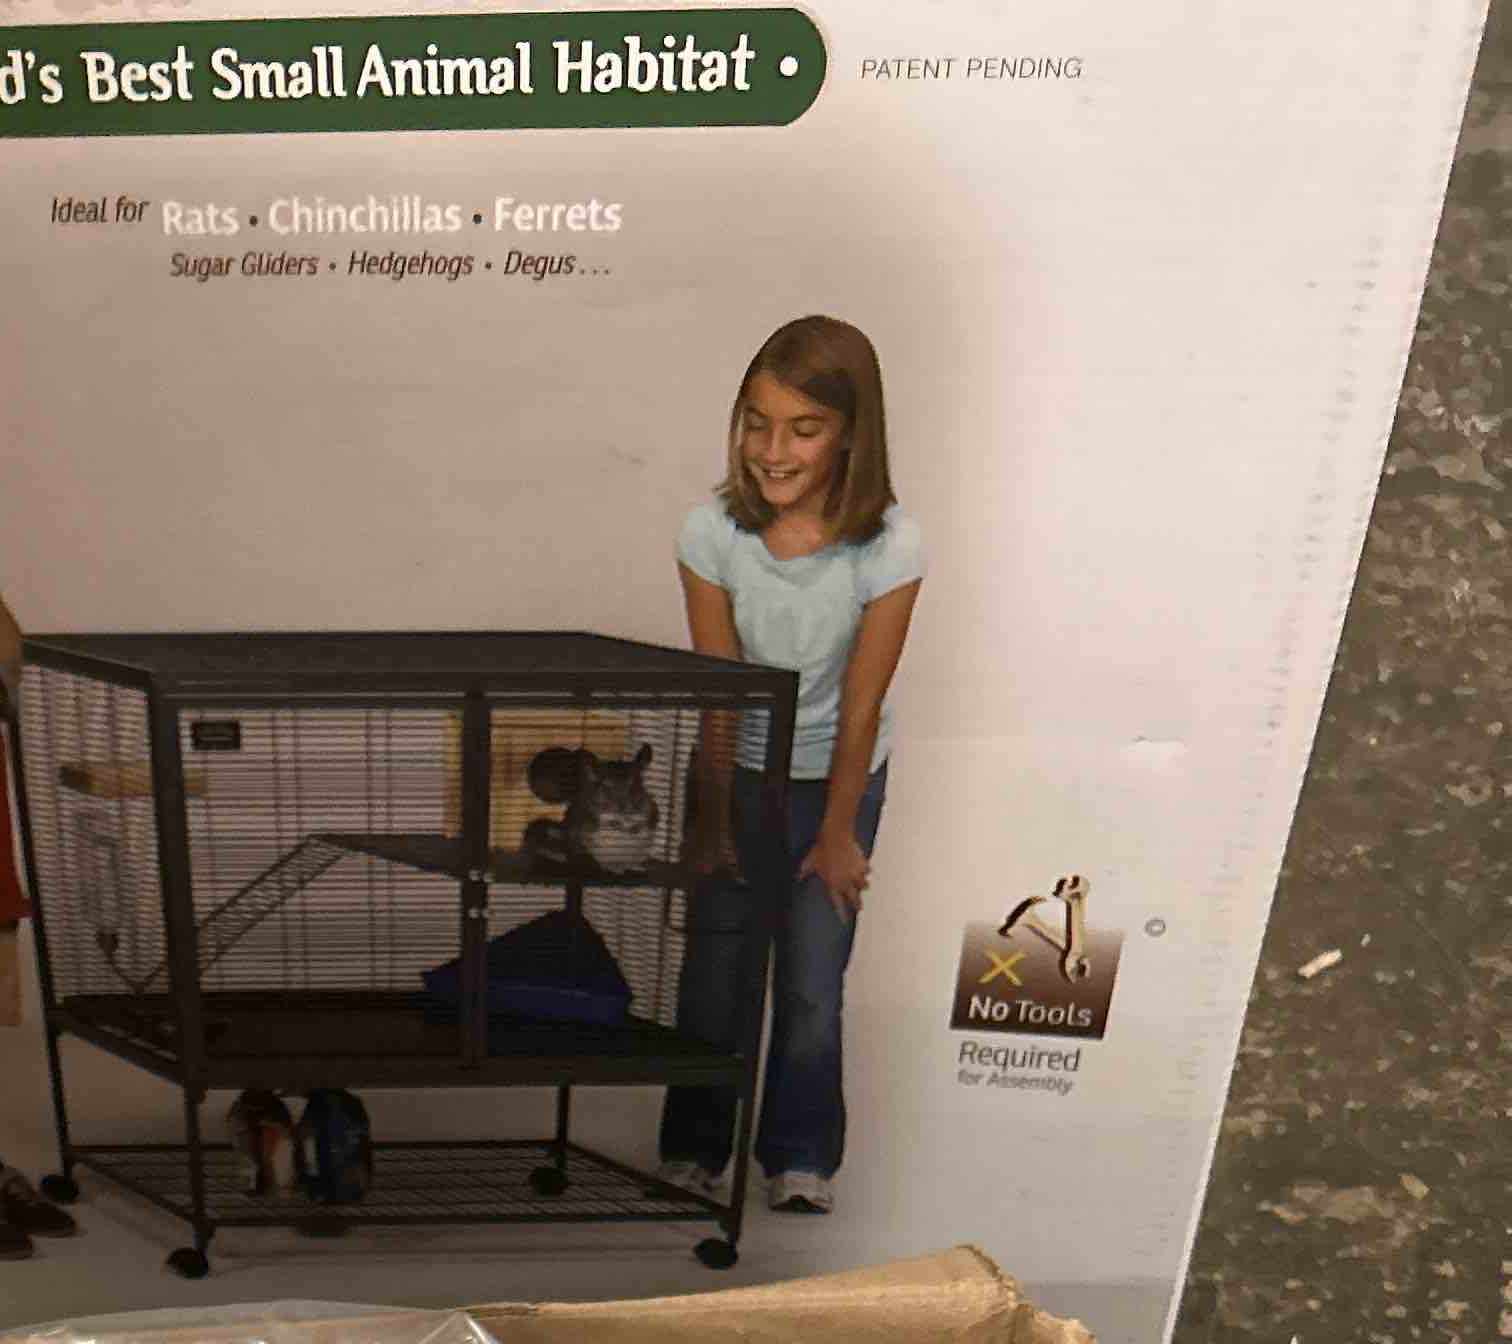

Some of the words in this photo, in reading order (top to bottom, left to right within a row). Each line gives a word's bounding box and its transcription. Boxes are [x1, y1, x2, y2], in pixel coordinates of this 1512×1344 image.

[80, 44, 193, 102] Best
[211, 45, 345, 100] Small
[356, 42, 534, 97] Animal
[552, 33, 755, 94] Habitat
[860, 57, 956, 80] PATENT
[966, 56, 1083, 79] PENDING
[50, 197, 108, 224] Ideal
[113, 197, 150, 225] for
[162, 201, 239, 236] Rats
[269, 195, 462, 235] Chinchillas
[493, 197, 623, 233] Ferrets
[170, 251, 235, 281] Sugar
[240, 250, 318, 277] Gliders
[348, 250, 474, 281] Hedgehogs
[968, 995, 1009, 1020] No
[1016, 999, 1092, 1027] Tools
[958, 1040, 1081, 1073] Required
[958, 1069, 985, 1086] for
[987, 1072, 1073, 1096] Assembly
